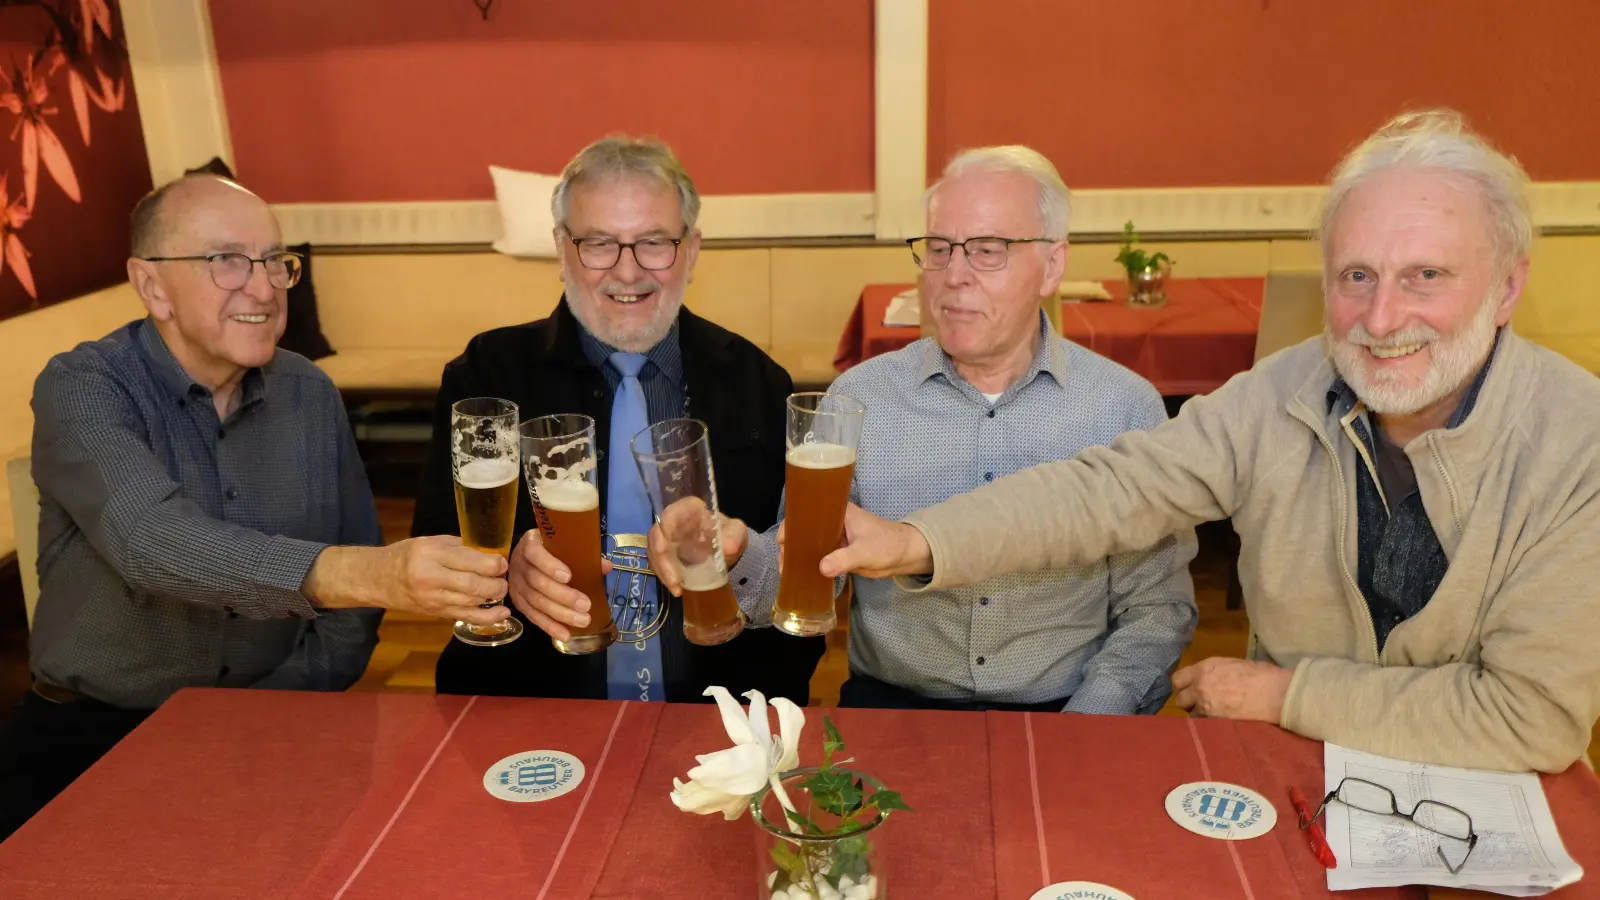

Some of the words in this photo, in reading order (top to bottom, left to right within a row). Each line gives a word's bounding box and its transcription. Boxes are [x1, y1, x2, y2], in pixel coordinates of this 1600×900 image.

[509, 756, 571, 770] BRAUHAUS
[508, 769, 574, 794] BAYREUTHER
[1181, 787, 1217, 818] BRAUHAUS
[1222, 788, 1262, 829] BAYREUTHER
